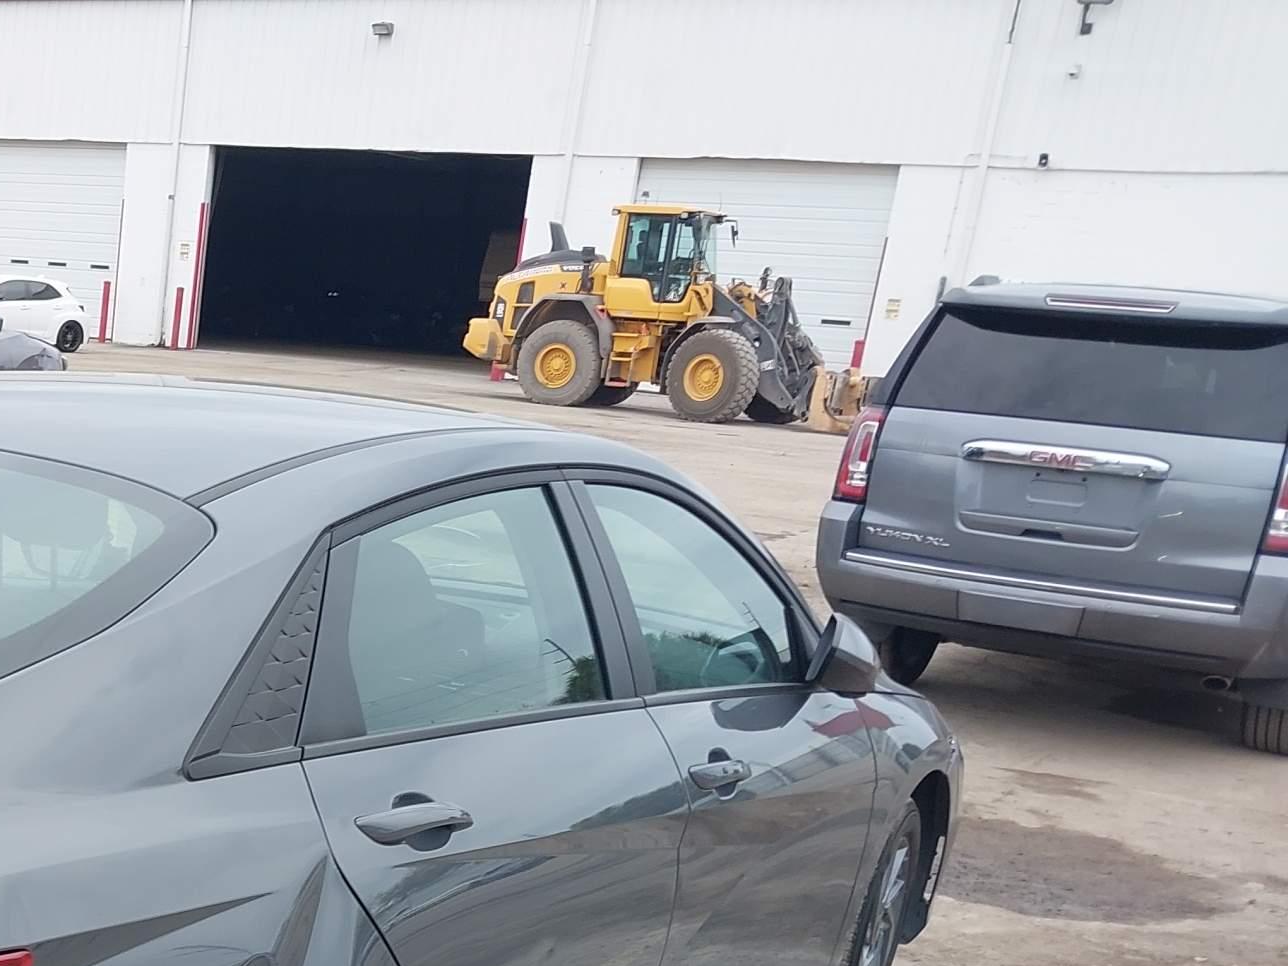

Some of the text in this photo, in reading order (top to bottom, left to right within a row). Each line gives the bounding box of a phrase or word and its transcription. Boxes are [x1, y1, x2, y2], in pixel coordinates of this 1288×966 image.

[1028, 450, 1094, 469] GMC
[865, 526, 951, 547] YUKON XL
